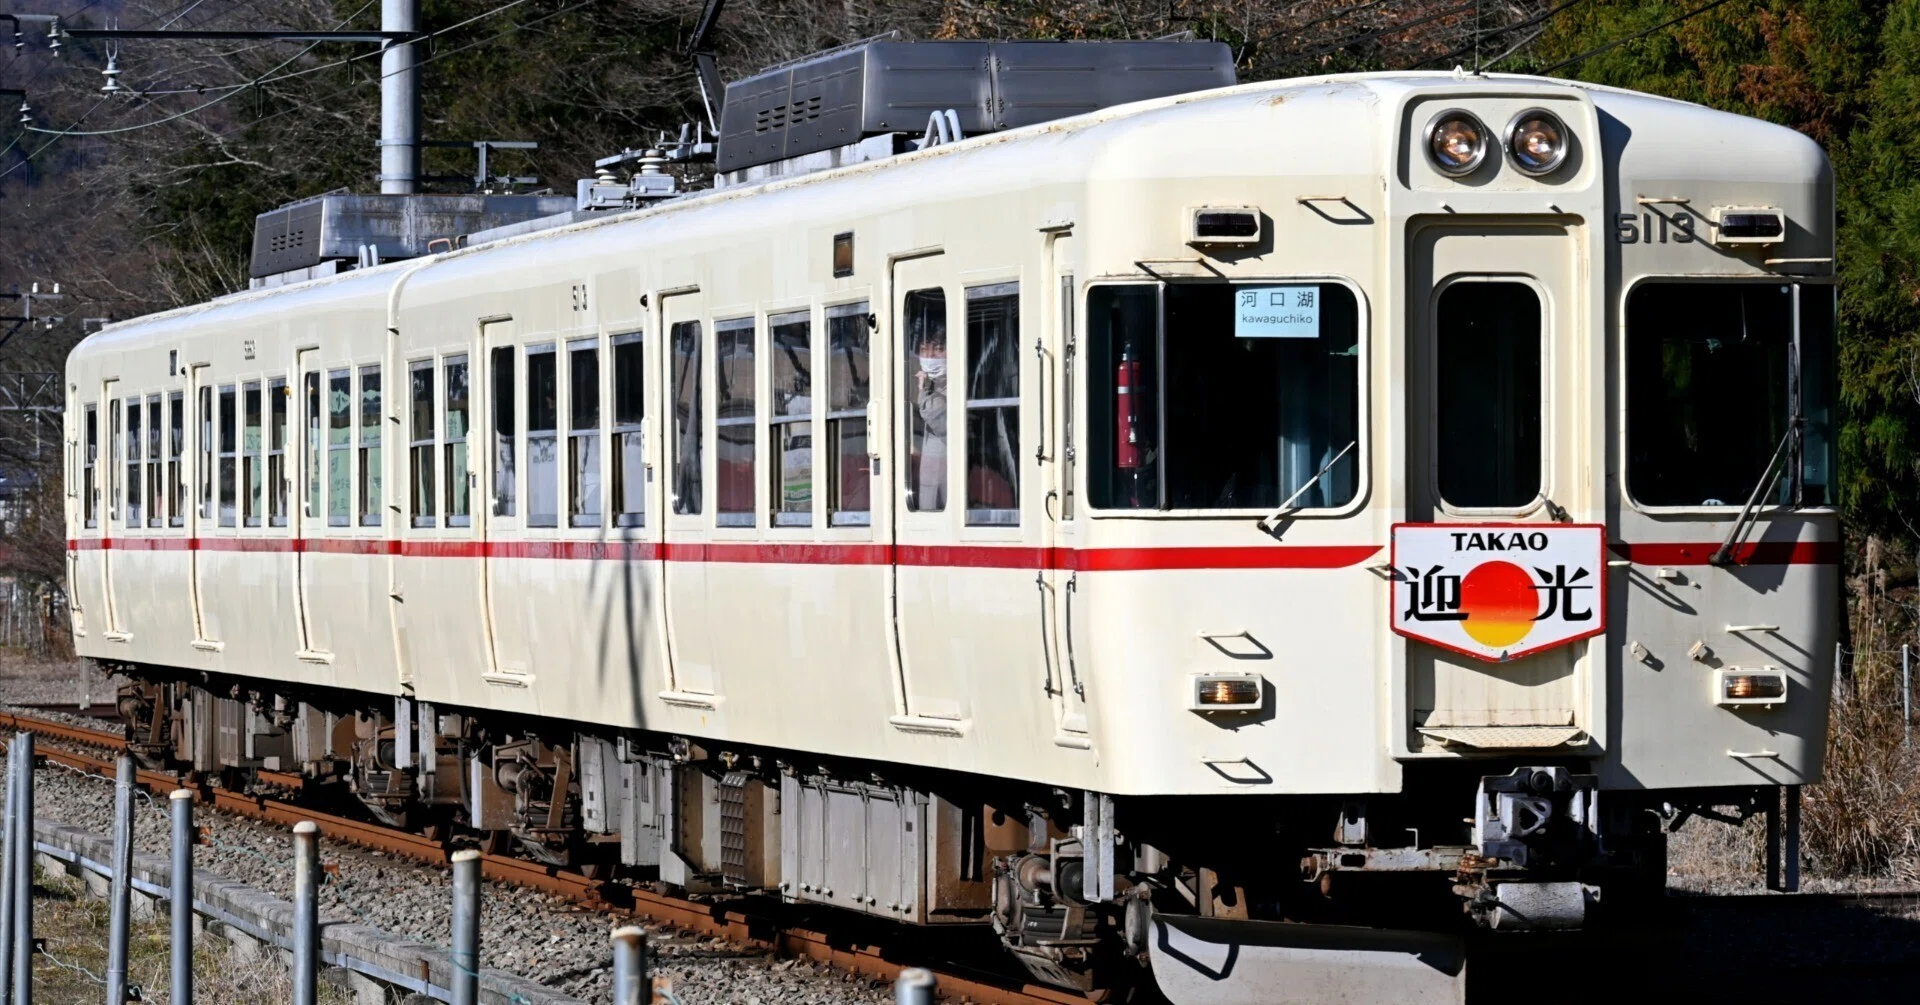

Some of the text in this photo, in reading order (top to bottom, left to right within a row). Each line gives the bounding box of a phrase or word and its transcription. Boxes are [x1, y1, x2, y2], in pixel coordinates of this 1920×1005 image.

[1615, 212, 1694, 244] 5113
[1241, 291, 1314, 308] 河口湖
[1242, 314, 1313, 324] kawaguchiko
[1450, 532, 1548, 551] TAKAO
[1405, 564, 1593, 621] 迎光
